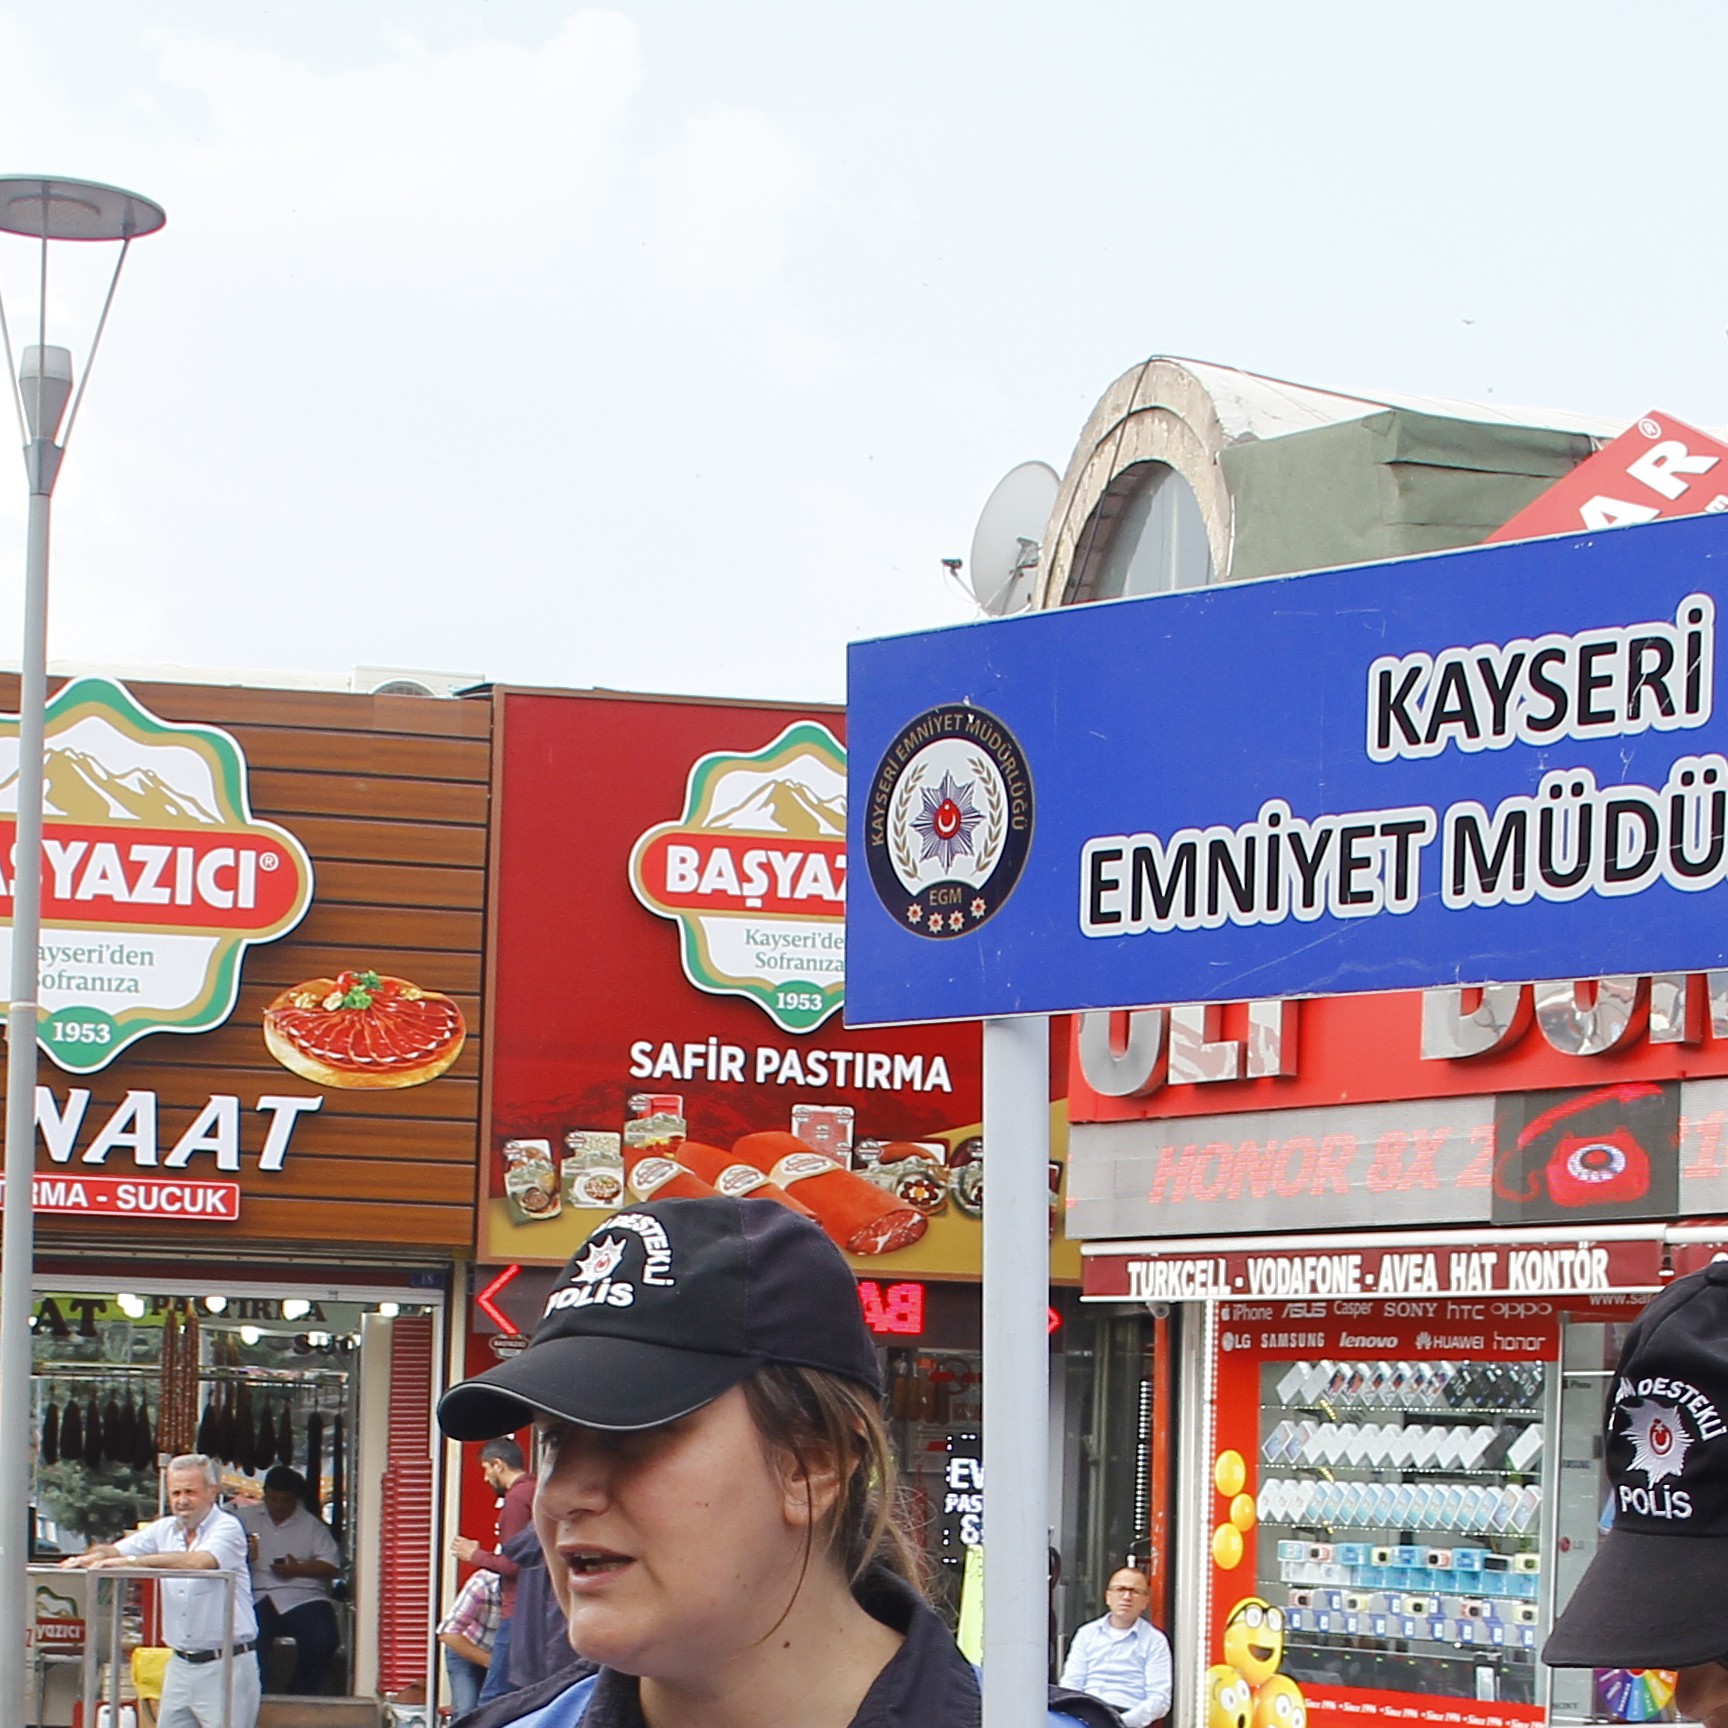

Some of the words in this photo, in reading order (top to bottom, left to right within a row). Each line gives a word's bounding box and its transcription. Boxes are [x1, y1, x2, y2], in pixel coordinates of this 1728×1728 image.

[1370, 595, 1712, 758] KAYSERİ
[1084, 803, 1432, 936] EMNİYET
[928, 888, 963, 906] EGM
[744, 928, 845, 953] Kayseri'de
[37, 943, 155, 968] ayseri'den
[775, 991, 823, 1011] 1953
[52, 1020, 112, 1044] 1953
[628, 1036, 745, 1084] SAFİR
[755, 1046, 953, 1094] PASTIRMA
[116, 1184, 229, 1215] SUCUK
[1127, 1257, 1232, 1298] TURKCELL
[1247, 1254, 1362, 1295] VODAFONE
[1379, 1251, 1439, 1293] AVEA
[1450, 1251, 1497, 1292] HAT
[1509, 1241, 1610, 1290] KONTÖR
[1232, 1301, 1273, 1321] iPhone
[1333, 1300, 1374, 1318] Casper
[1384, 1302, 1436, 1317] SONY
[1233, 1333, 1251, 1349] LG
[1260, 1331, 1325, 1349] SAMSUNG
[1339, 1331, 1399, 1349] lenovo
[1433, 1335, 1484, 1350] HUAWEI
[1493, 1331, 1547, 1351] honor
[1638, 1377, 1728, 1441] DESTEKLİ
[1618, 1484, 1693, 1519] POLİS
